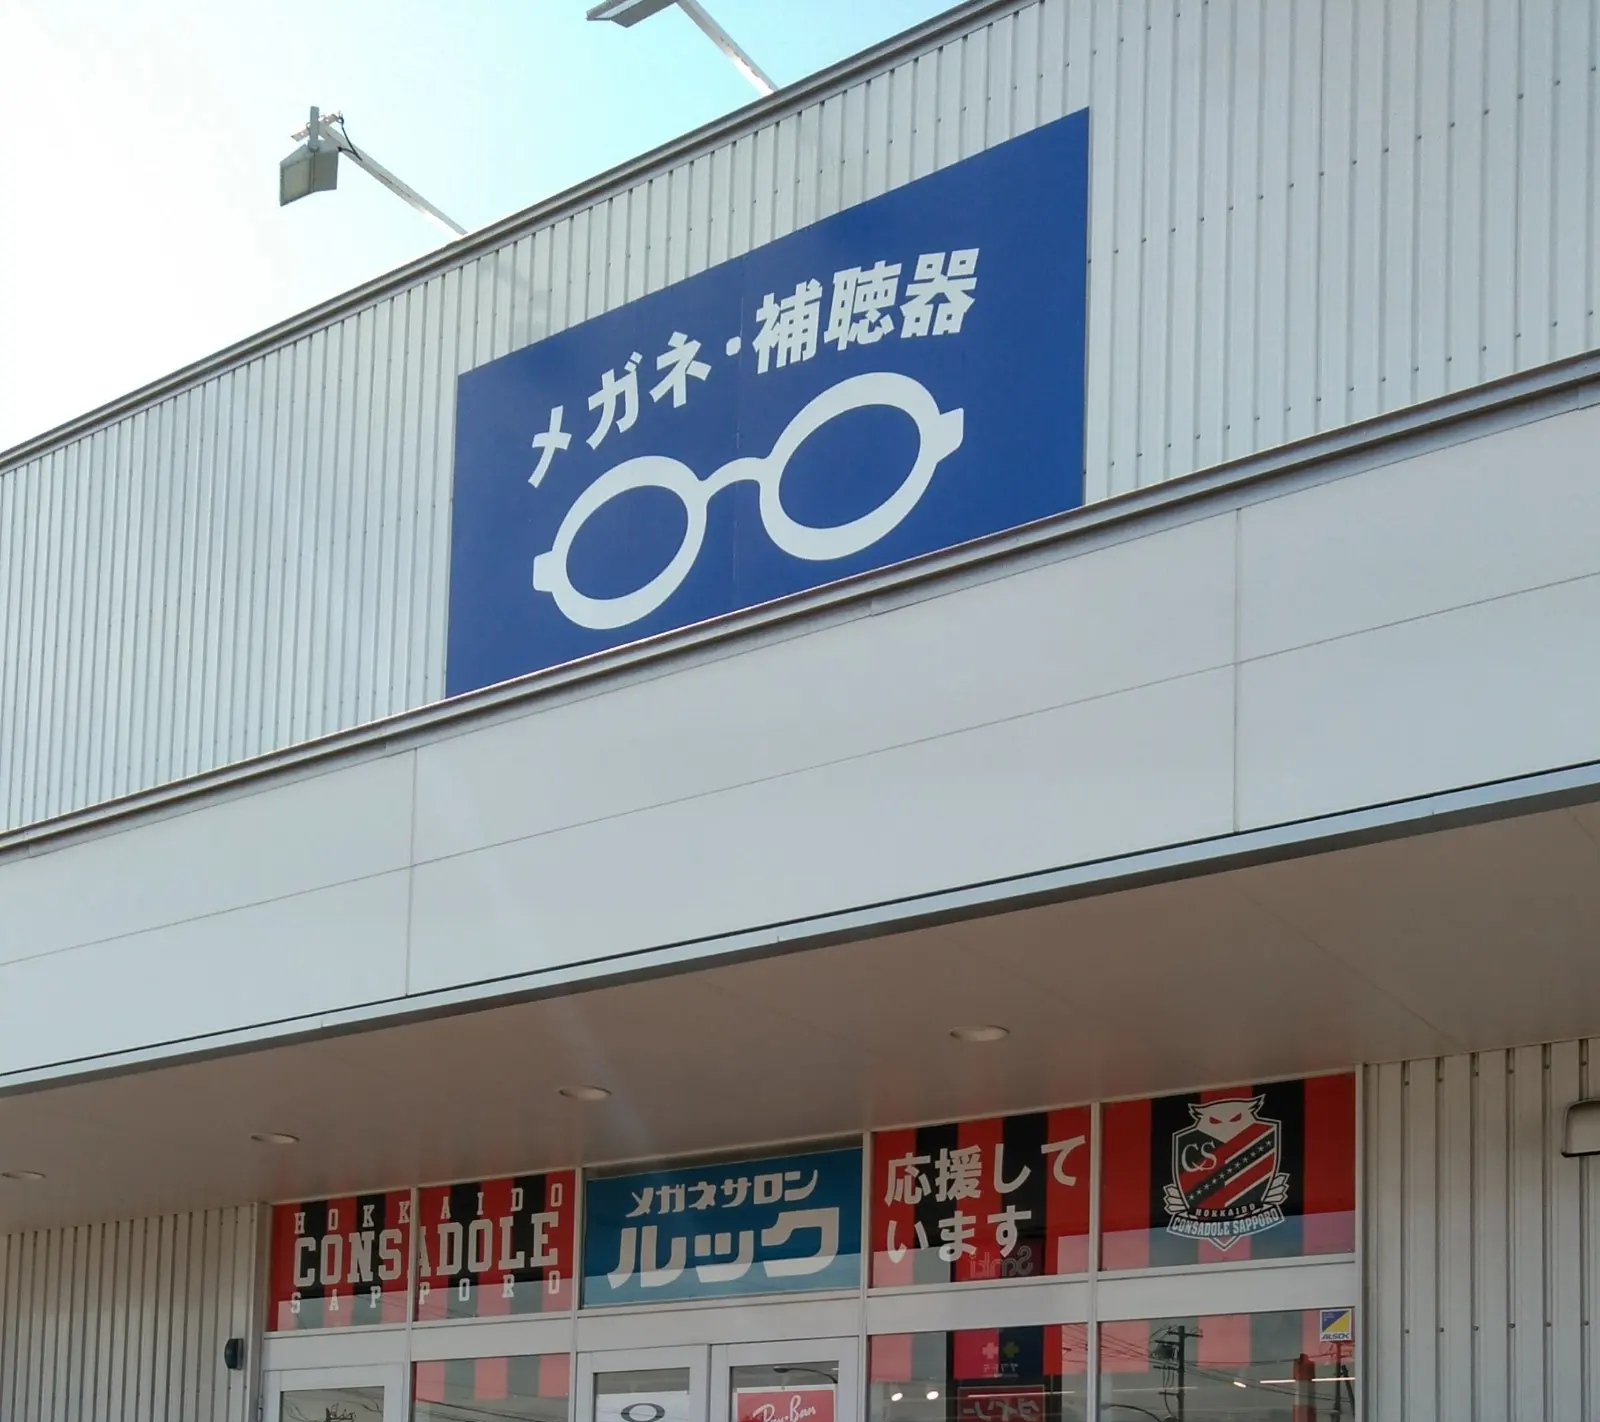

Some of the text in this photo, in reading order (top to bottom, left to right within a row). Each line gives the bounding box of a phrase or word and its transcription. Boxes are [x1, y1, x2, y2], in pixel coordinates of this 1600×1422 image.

[529, 248, 979, 488] メガネ・補聴器
[625, 1169, 818, 1218] メガネサロン
[884, 1135, 1087, 1206] 応援して
[295, 1183, 562, 1234] HOKKAIDO
[886, 1205, 1032, 1264] います
[1172, 1208, 1279, 1236] CONSADOLE SAPPORO
[1195, 1203, 1255, 1217] HOKKAIDO
[293, 1211, 559, 1287] CONSADOLE
[607, 1207, 839, 1290] ルック
[291, 1270, 560, 1314] SAPPORO
